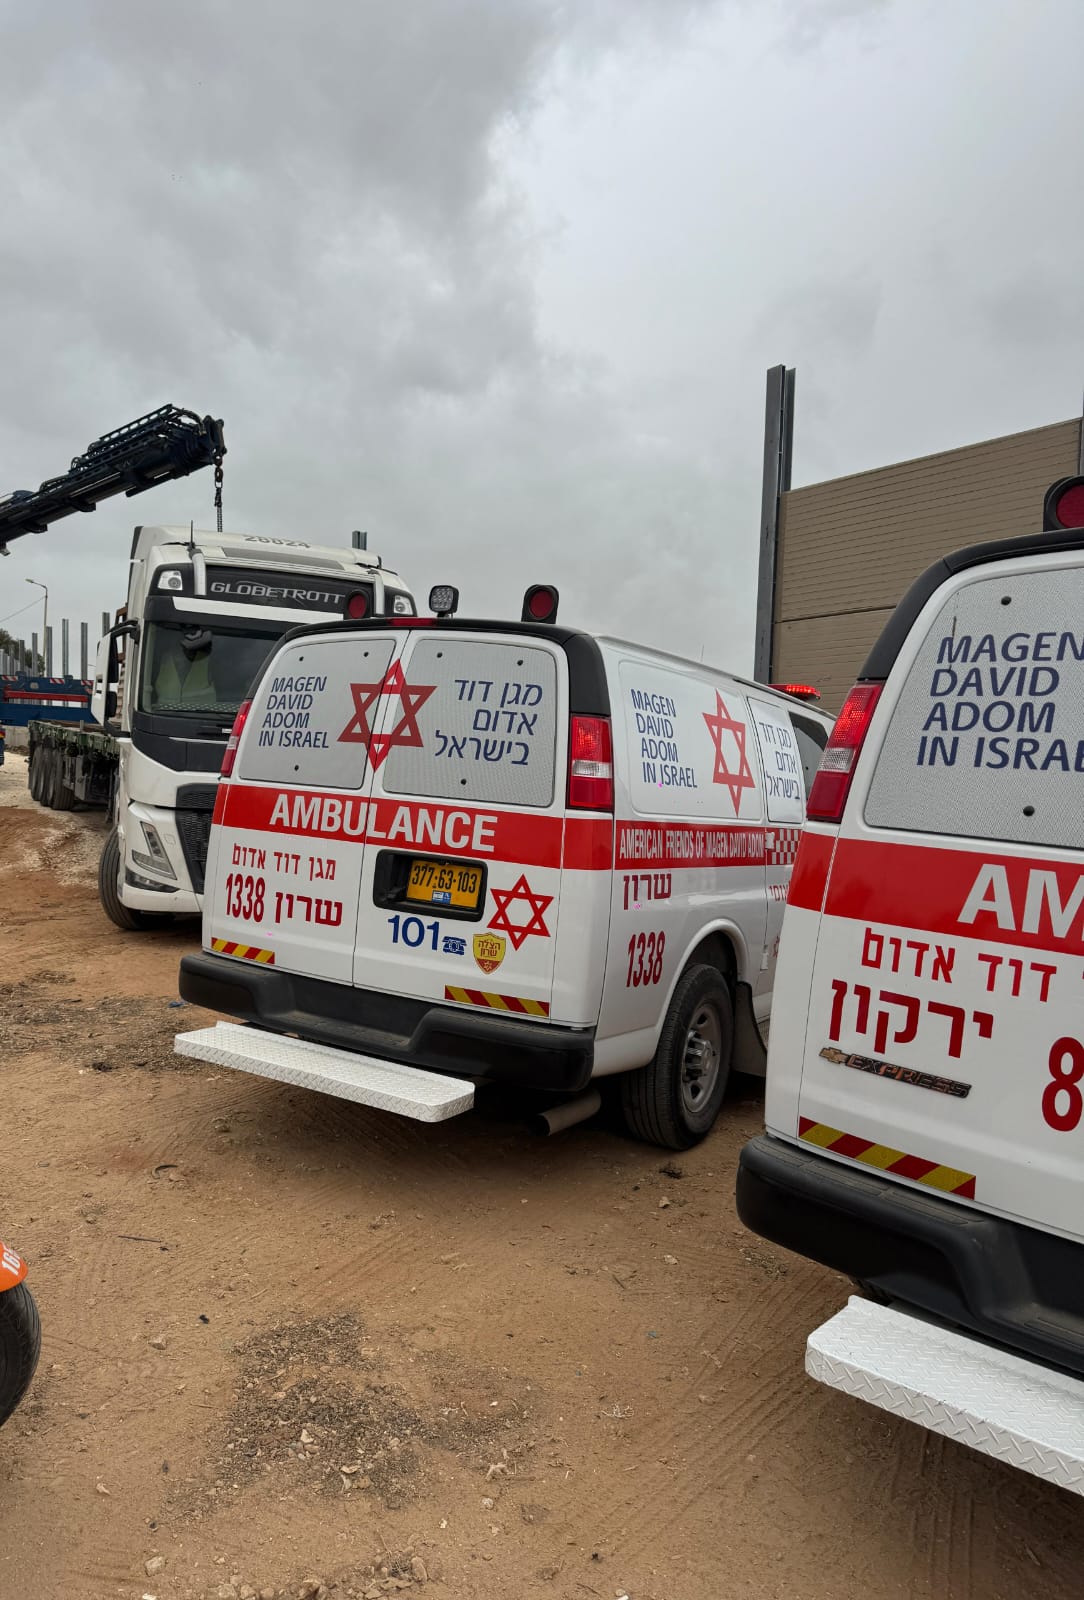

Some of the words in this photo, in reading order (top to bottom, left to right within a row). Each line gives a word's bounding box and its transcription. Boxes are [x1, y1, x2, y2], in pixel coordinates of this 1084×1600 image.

[936, 632, 1084, 664] MAGEN
[270, 676, 327, 692] MAGEN
[454, 679, 493, 702] דוד
[500, 682, 542, 708] מגן
[930, 666, 1060, 696] DAVID
[266, 694, 313, 710] DAVID
[630, 688, 676, 718] MAGEN
[922, 700, 1056, 732] ADOM
[262, 712, 310, 729] ADOM
[472, 708, 538, 736] אדום
[636, 713, 674, 738] DAVID
[759, 722, 776, 744] דוד
[258, 730, 276, 747] IN
[278, 731, 329, 748] ISRAEL
[435, 730, 530, 765] בישראל
[642, 738, 678, 762] ADOM
[777, 728, 792, 750] מגן
[916, 736, 959, 766] IN
[642, 762, 656, 784] IN
[660, 764, 698, 788] ISRAEL
[776, 751, 797, 774] אדום
[766, 770, 800, 800] בישראל
[269, 794, 498, 852] AMBULANCE
[232, 842, 266, 870] אדום
[620, 828, 663, 860] AMERICAN
[666, 830, 694, 858] FRIENDS
[696, 830, 705, 858] OF
[706, 832, 728, 858] MAGEN
[730, 832, 746, 858] DAVID
[748, 832, 764, 858] ADOM
[274, 852, 300, 875] דוד
[309, 856, 336, 881] מגן
[226, 872, 266, 922] 1338
[624, 873, 672, 910] שרון
[275, 892, 342, 926] שרון
[388, 914, 440, 950] 101
[478, 938, 500, 950] הצלה
[480, 948, 498, 957] שרון
[626, 930, 666, 988] 1338
[861, 927, 956, 984] אדום
[978, 952, 1058, 1002] דוד
[828, 978, 994, 1058] ירקון
[846, 1053, 972, 1098] EXPRESS
[1042, 1036, 1084, 1132] 8
